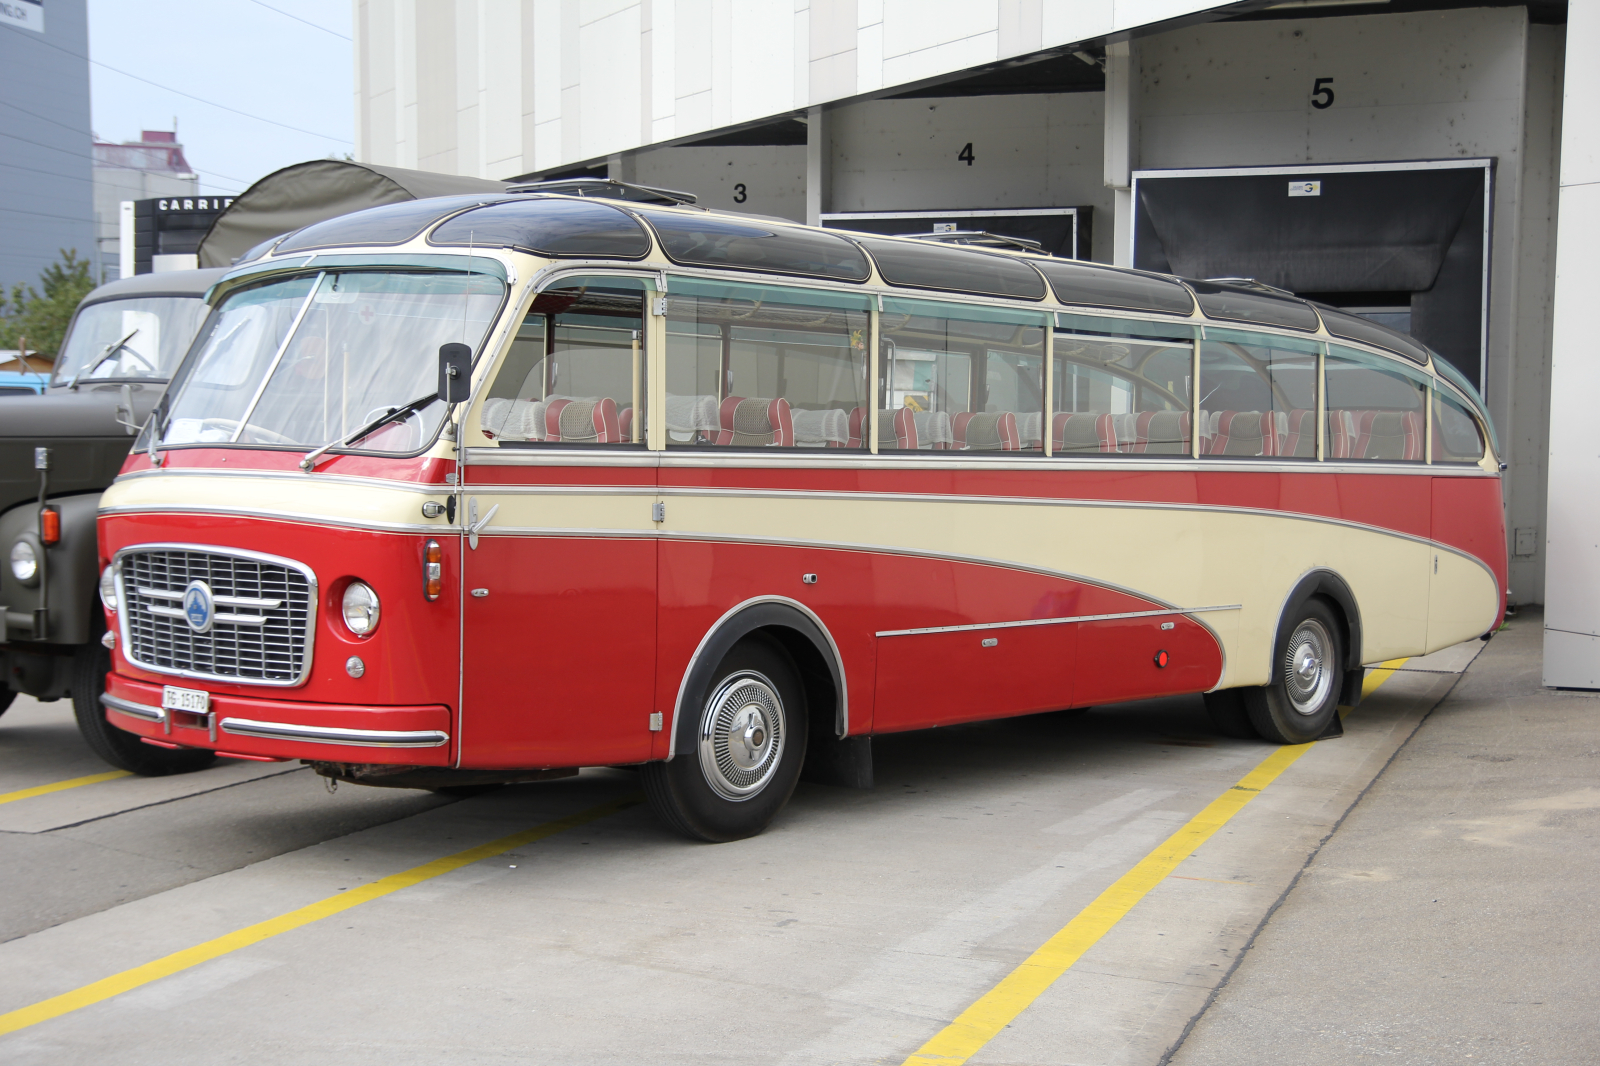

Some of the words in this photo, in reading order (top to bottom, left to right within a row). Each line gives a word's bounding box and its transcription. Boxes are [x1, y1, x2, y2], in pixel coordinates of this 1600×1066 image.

[1311, 77, 1335, 110] 5
[957, 142, 976, 167] 4
[733, 183, 747, 204] 3
